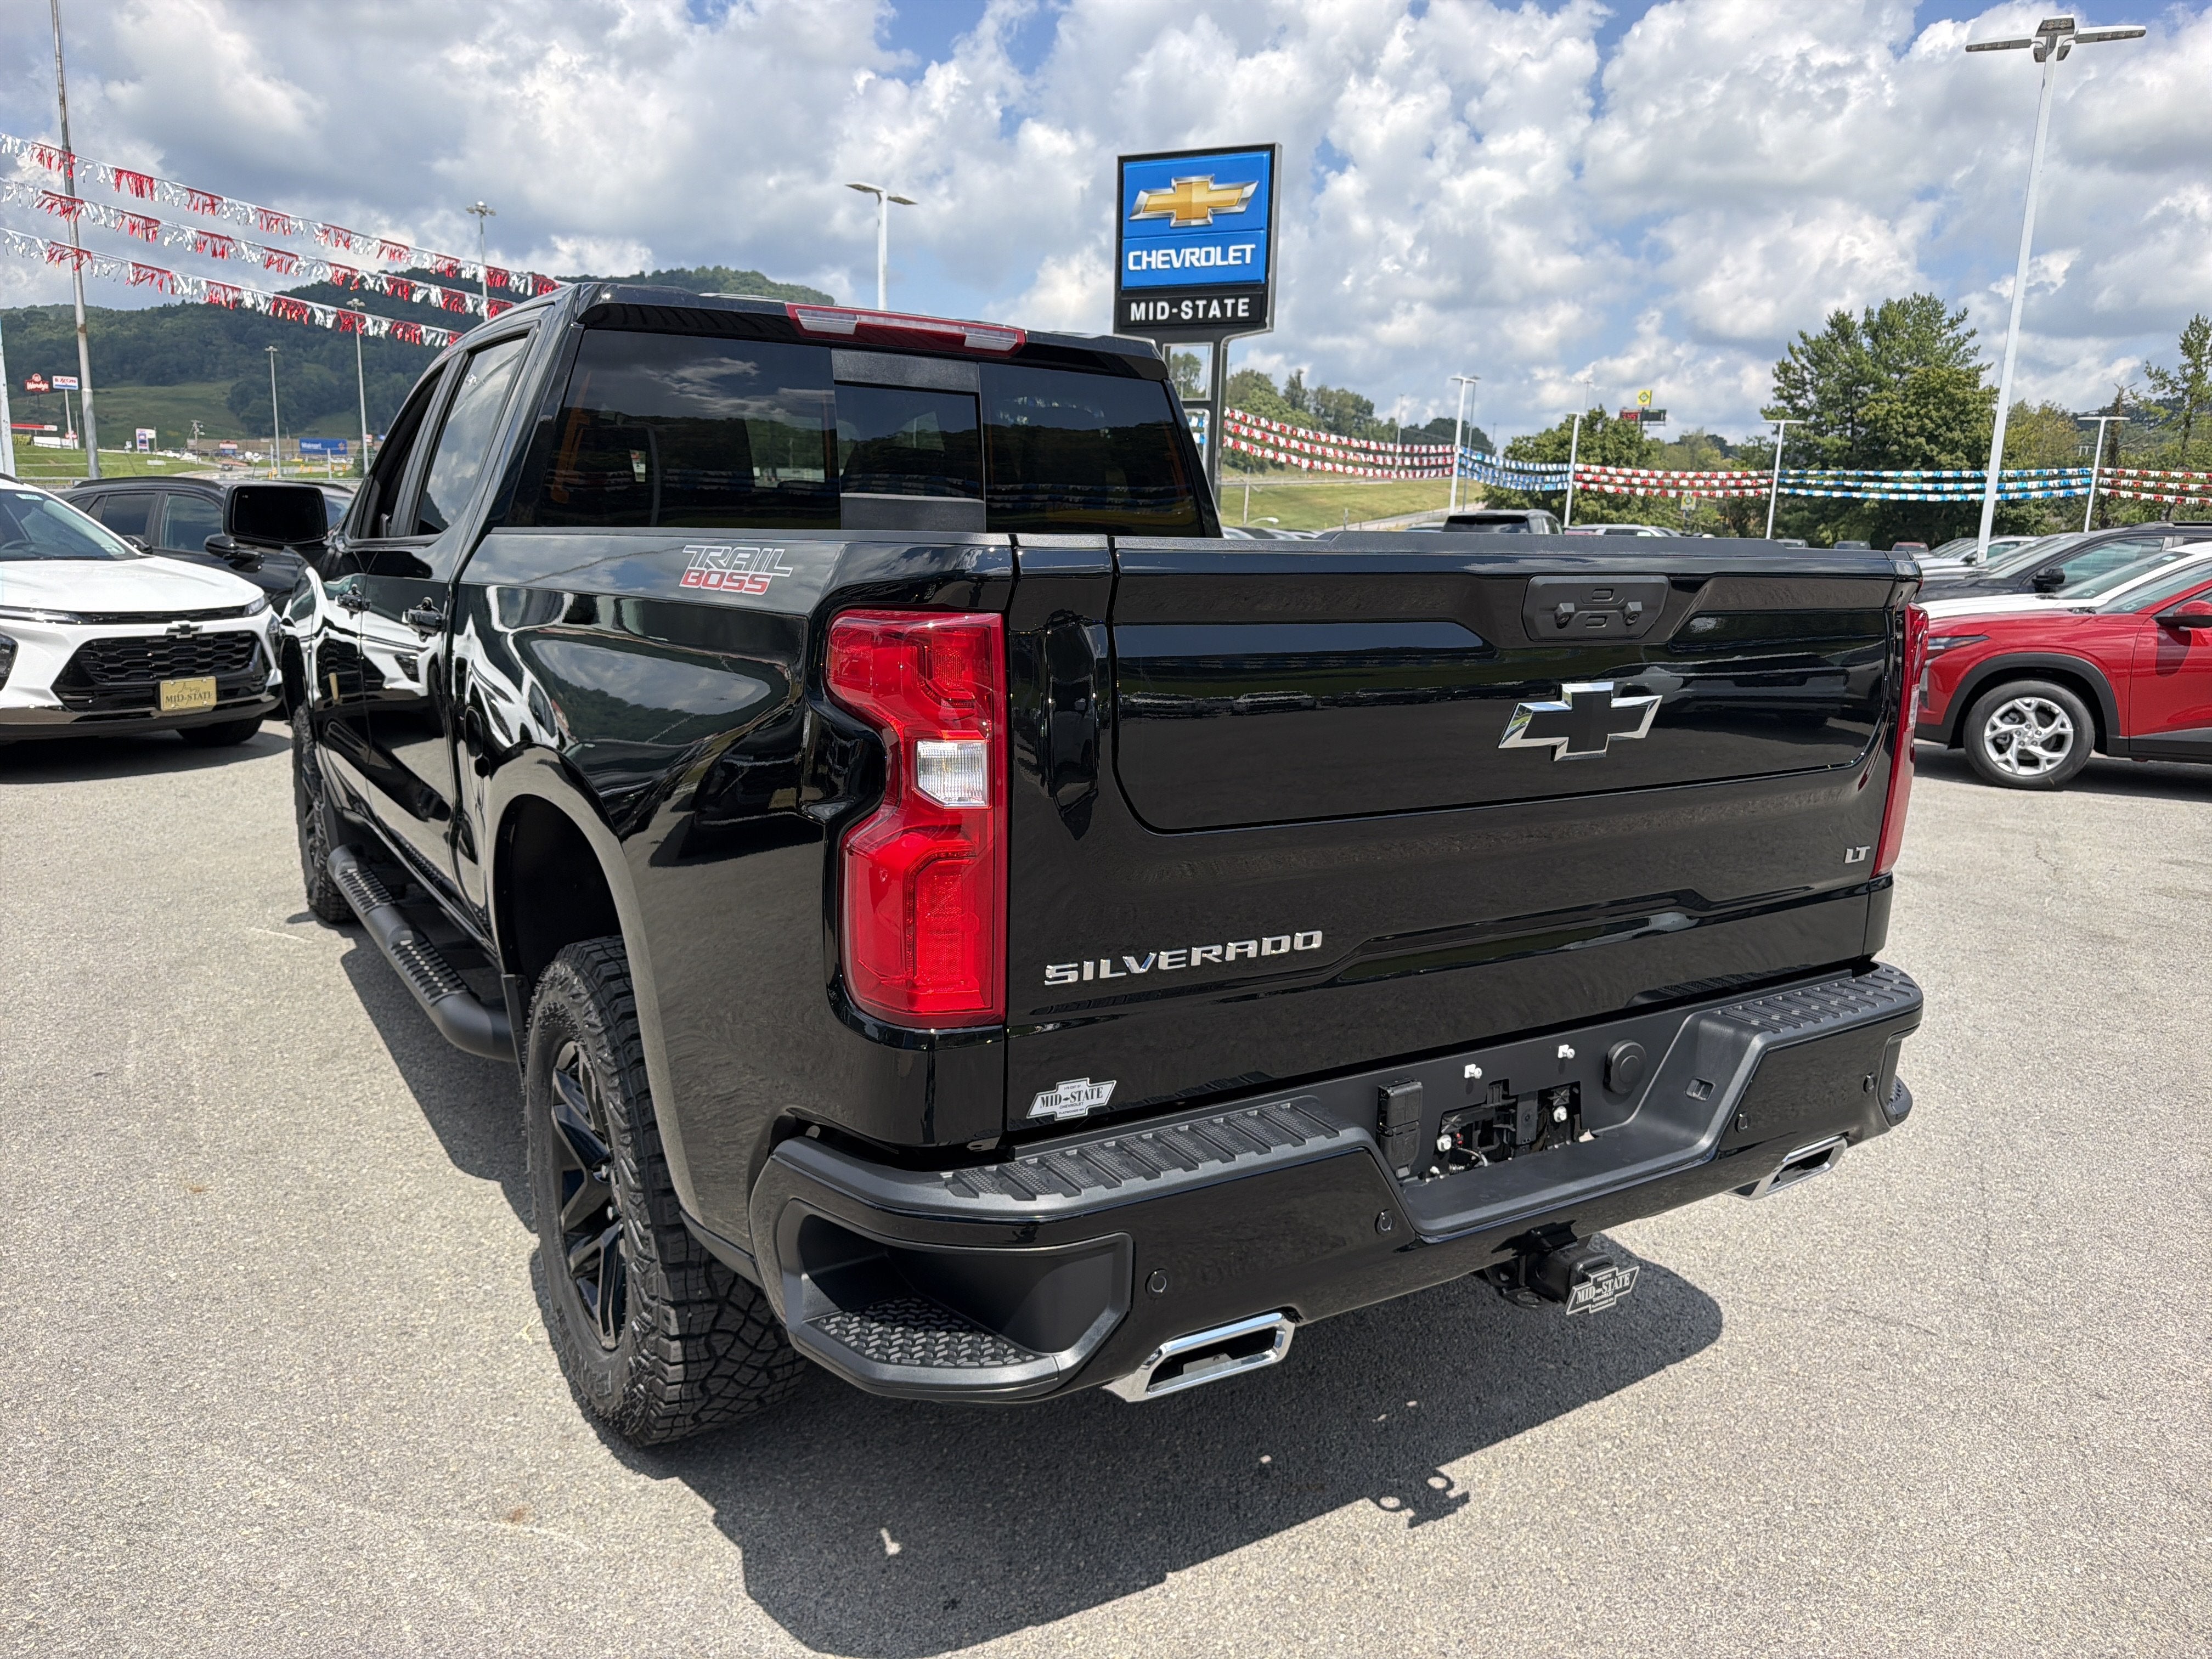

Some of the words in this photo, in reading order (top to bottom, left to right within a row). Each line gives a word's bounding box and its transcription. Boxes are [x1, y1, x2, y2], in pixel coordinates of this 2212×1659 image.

[1128, 244, 1256, 270] CHEVROLET
[1130, 297, 1250, 321] MID-STATE
[682, 545, 794, 577] TRAIL
[679, 567, 773, 595] BOSS
[166, 691, 212, 703] MID-STATE
[1844, 846, 1871, 864] LT
[1044, 930, 1323, 985] SILVERADO
[1040, 1087, 1103, 1108] MID-STATE
[1576, 1272, 1630, 1304] MID-STATE
